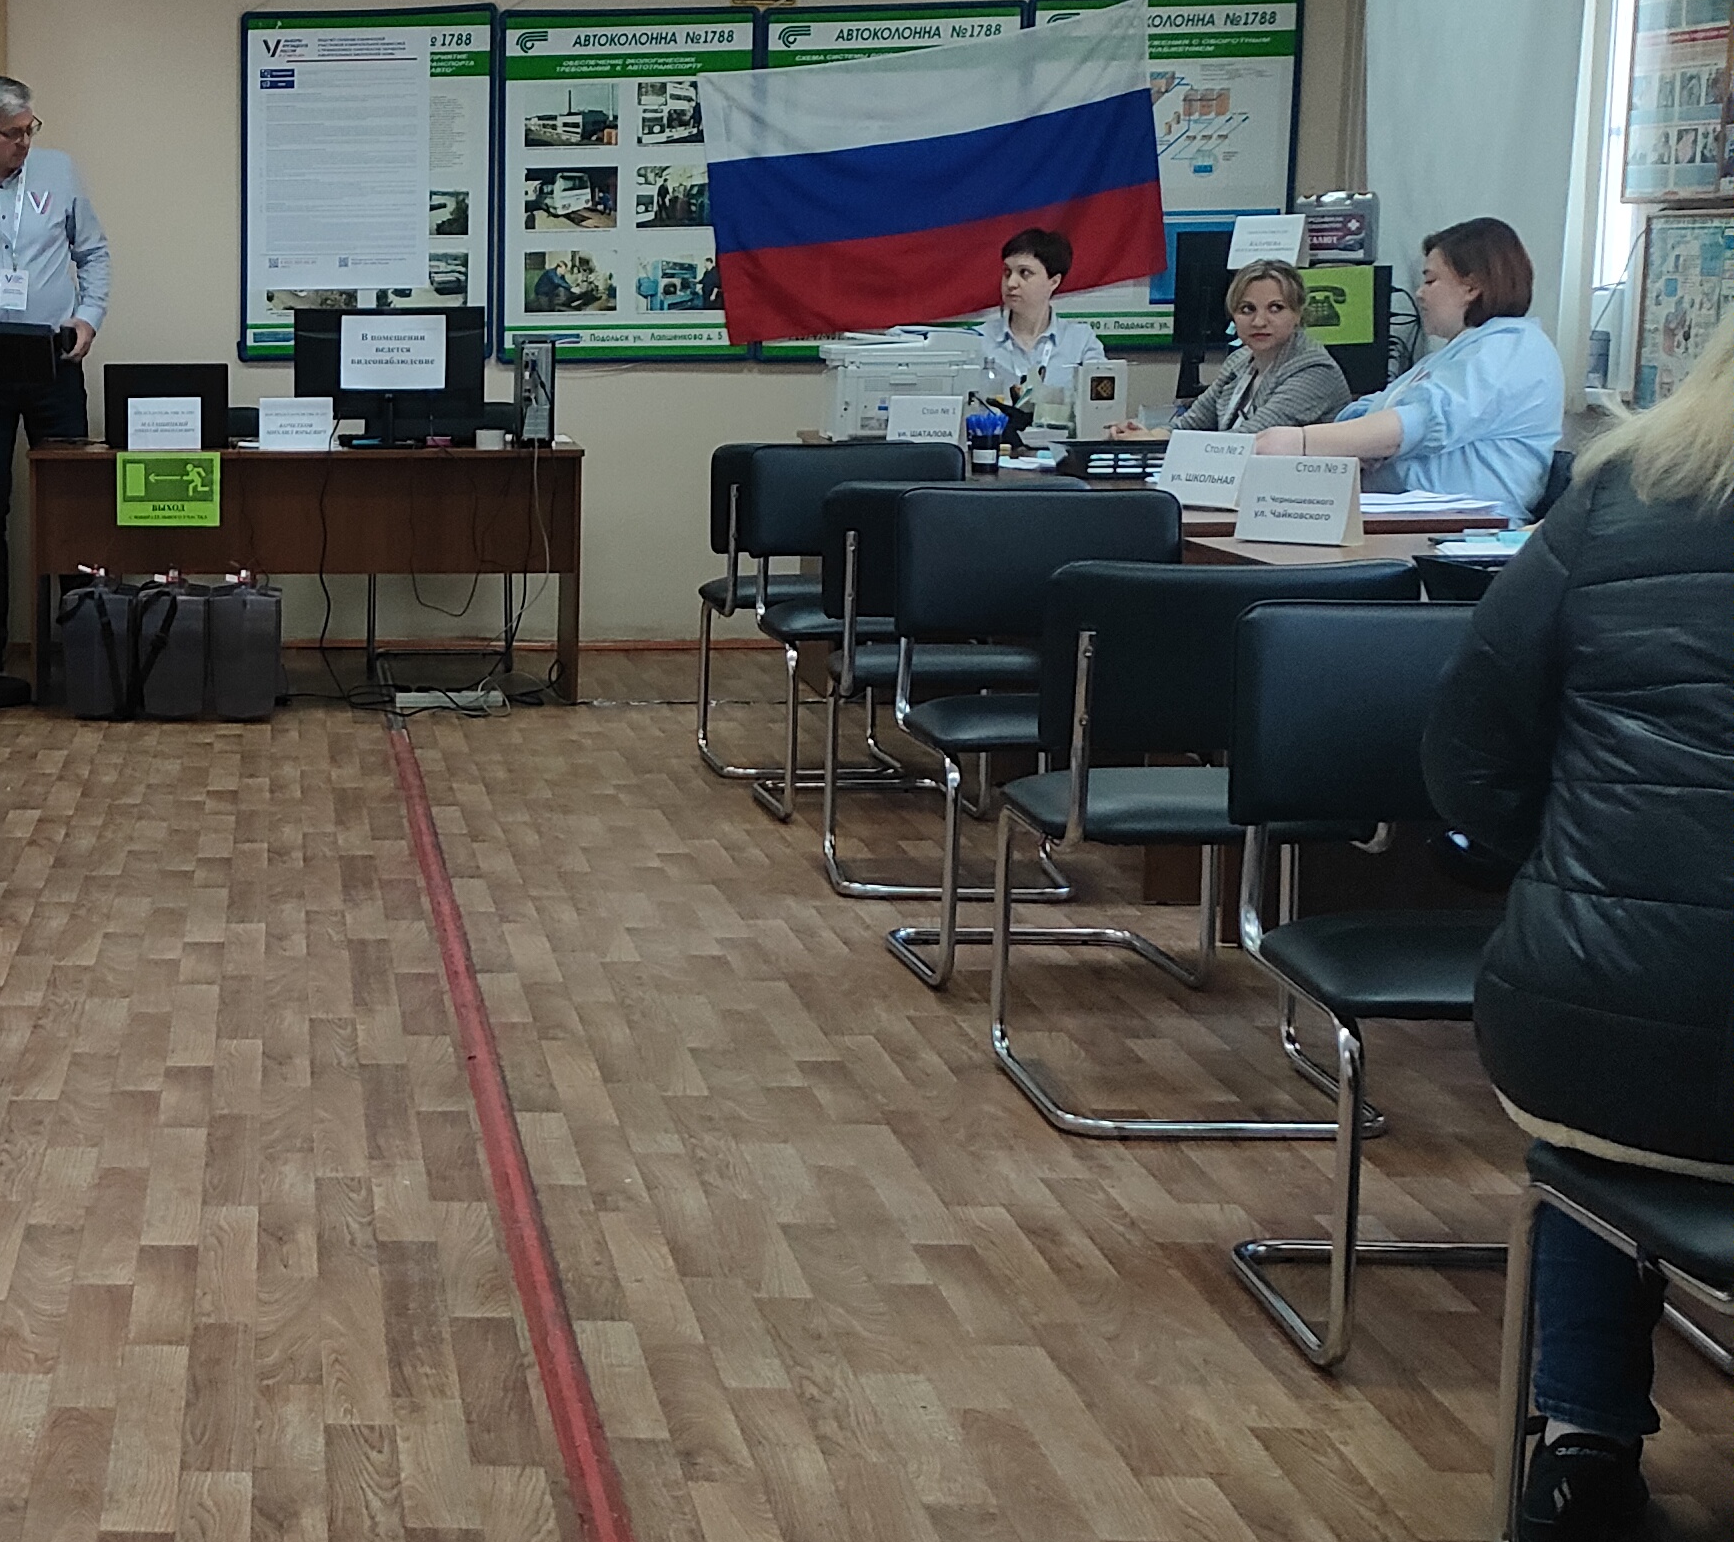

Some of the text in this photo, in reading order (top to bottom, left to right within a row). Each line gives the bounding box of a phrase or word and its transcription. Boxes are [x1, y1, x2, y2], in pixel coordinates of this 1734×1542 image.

[1224, 11, 1277, 26] №1788
[572, 29, 735, 48] АВТОКОЛОННА №1788
[835, 25, 942, 42] АВТОКОЛОННА
[1113, 320, 1155, 330] Подольск
[361, 333, 425, 343] В помещении
[590, 333, 629, 343] Подольск
[717, 332, 723, 340] 5
[375, 346, 411, 354] ведется
[351, 357, 435, 365] видеонаблюдение
[921, 407, 939, 415] Стол
[909, 430, 953, 438] ШАТАЛОВА
[1204, 443, 1245, 455] Стол № 2
[1295, 461, 1348, 474] Стол № 3
[1171, 472, 1236, 485] ул. ШКОЛЬНАЯ
[1256, 495, 1335, 506] ул. Чернышевского
[152, 504, 186, 512] ВЫХОД
[1254, 508, 1332, 521] ул. Чайковского
